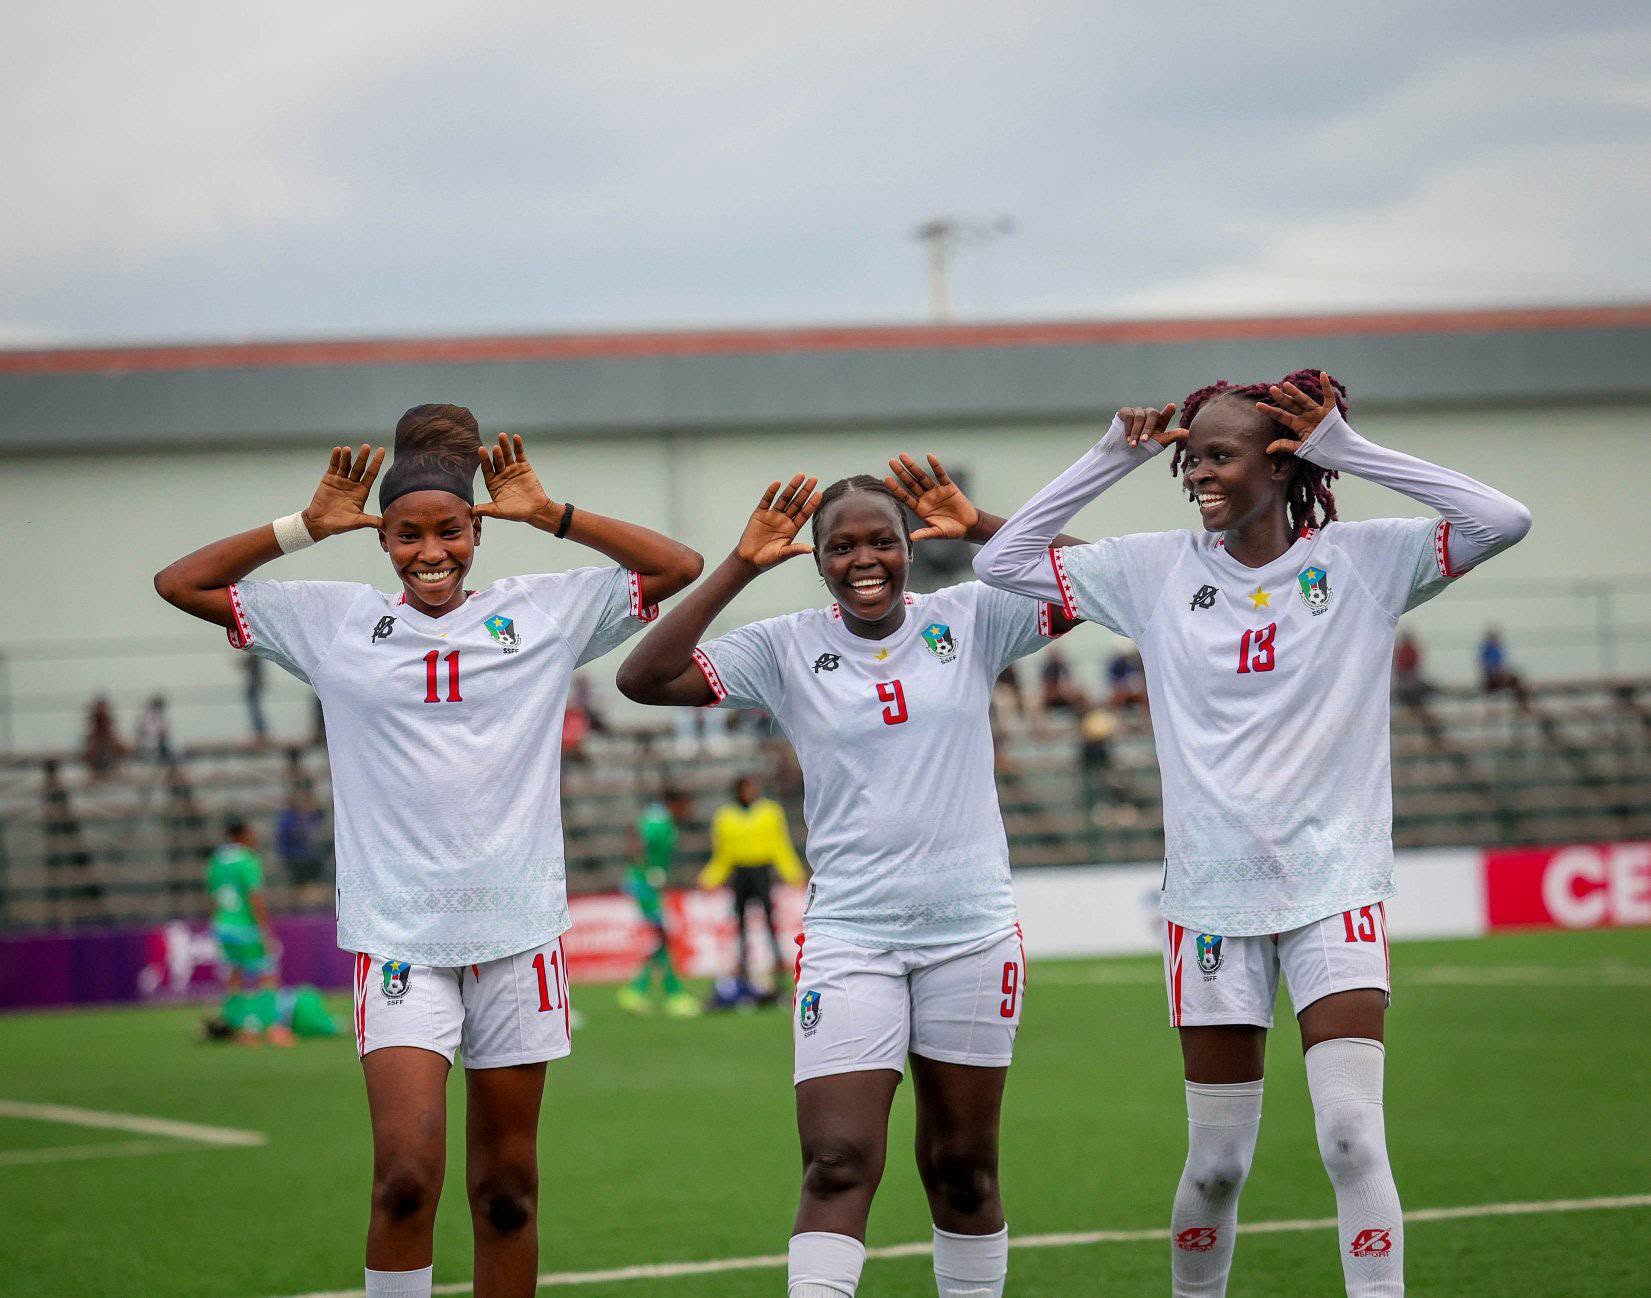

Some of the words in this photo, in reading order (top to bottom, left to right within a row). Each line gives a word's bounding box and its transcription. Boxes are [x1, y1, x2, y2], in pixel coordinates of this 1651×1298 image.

[940, 654, 957, 665] SSFF
[1236, 622, 1277, 674] 13
[422, 649, 463, 703] 11
[875, 679, 909, 726] 9
[1342, 905, 1377, 943] 13
[386, 998, 404, 1006] SSFF
[531, 949, 563, 1013] 11
[1000, 961, 1019, 1018] 9
[1357, 1249, 1392, 1258] SPORT
